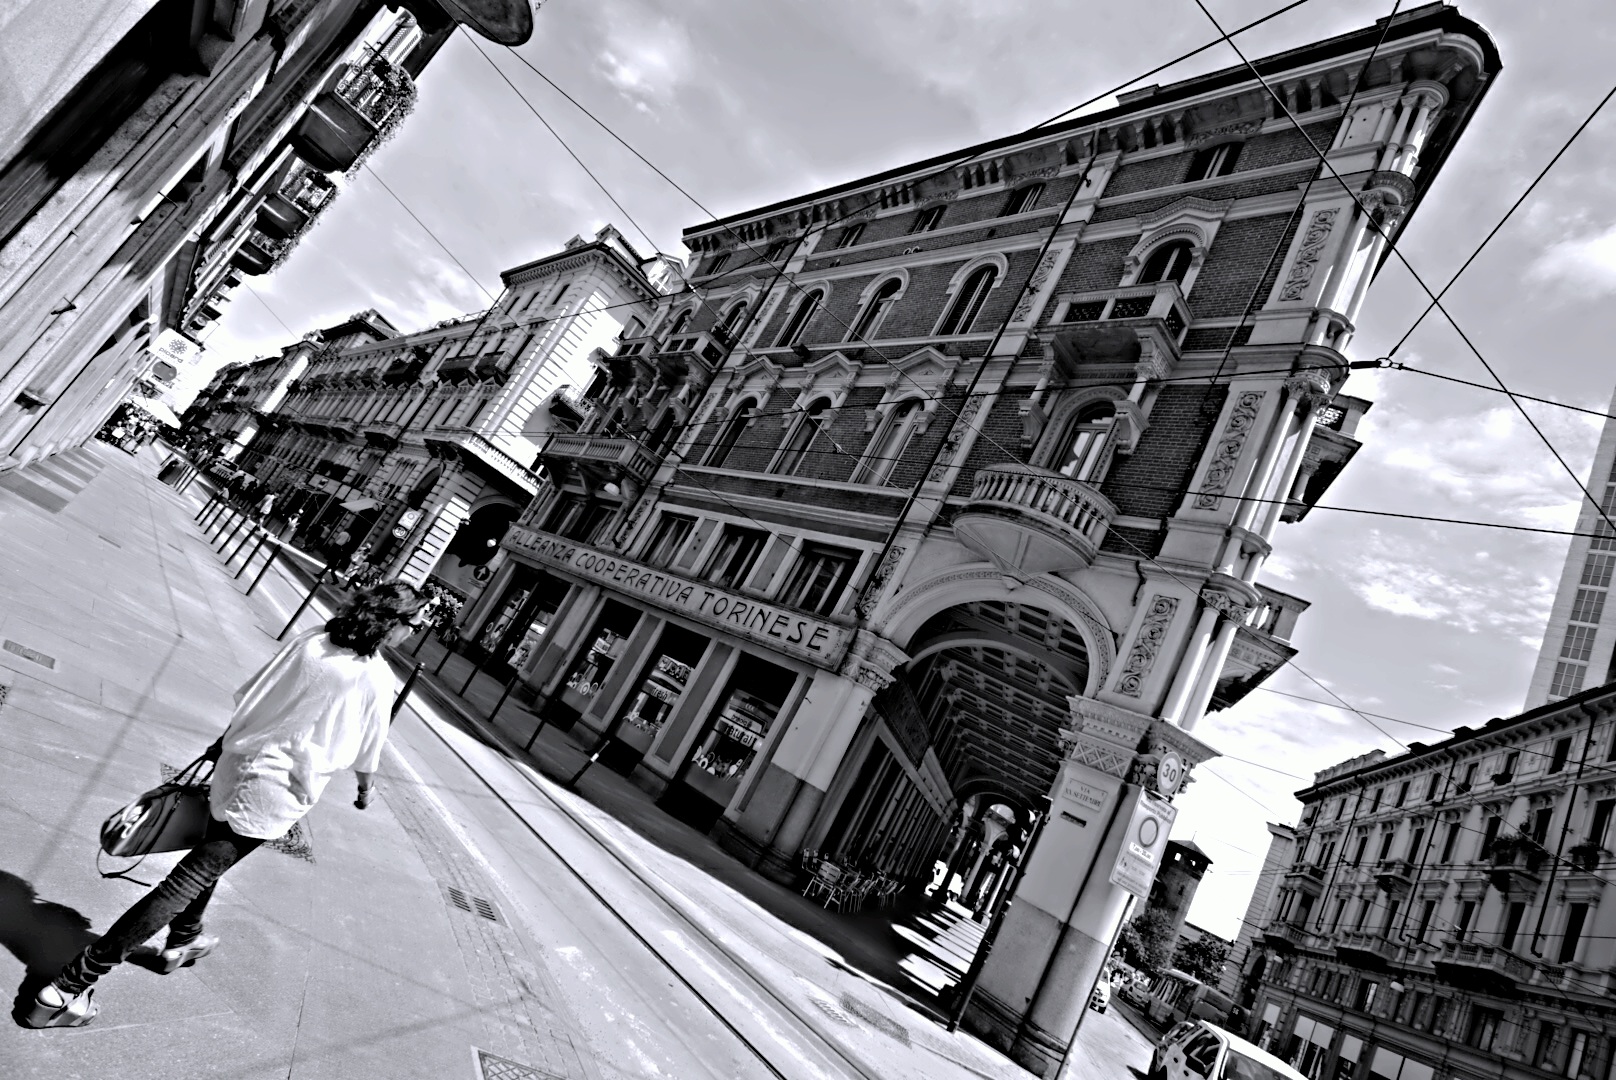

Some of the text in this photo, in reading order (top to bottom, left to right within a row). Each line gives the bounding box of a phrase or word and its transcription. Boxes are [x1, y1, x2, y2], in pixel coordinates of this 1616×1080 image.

[159, 347, 183, 363] picard
[509, 530, 829, 650] ALLEANZA COOPERATIVA TORINESE
[1162, 763, 1177, 782] 30
[1080, 785, 1090, 795] VIA
